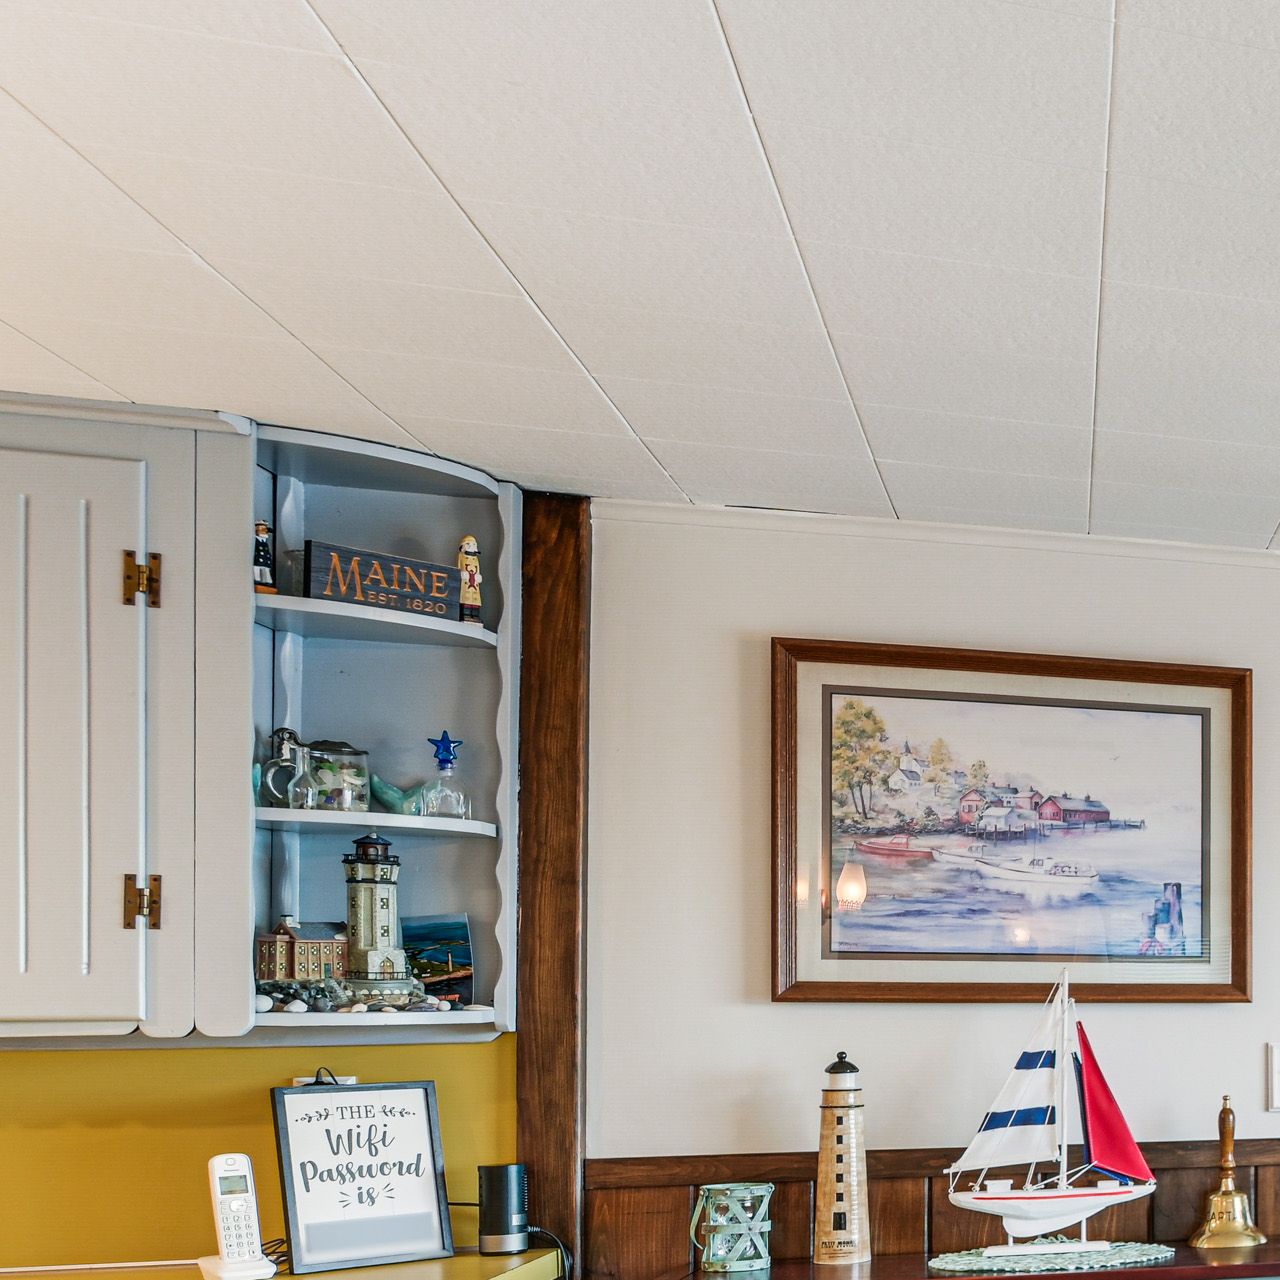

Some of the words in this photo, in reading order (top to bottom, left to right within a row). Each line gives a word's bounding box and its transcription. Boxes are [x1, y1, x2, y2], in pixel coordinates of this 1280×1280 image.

[323, 551, 449, 601] MAINE
[406, 598, 448, 615] 1820
[336, 1104, 376, 1120] THE
[325, 1123, 396, 1157] Wifi
[299, 1153, 426, 1193] Password
[357, 1186, 380, 1207] is
